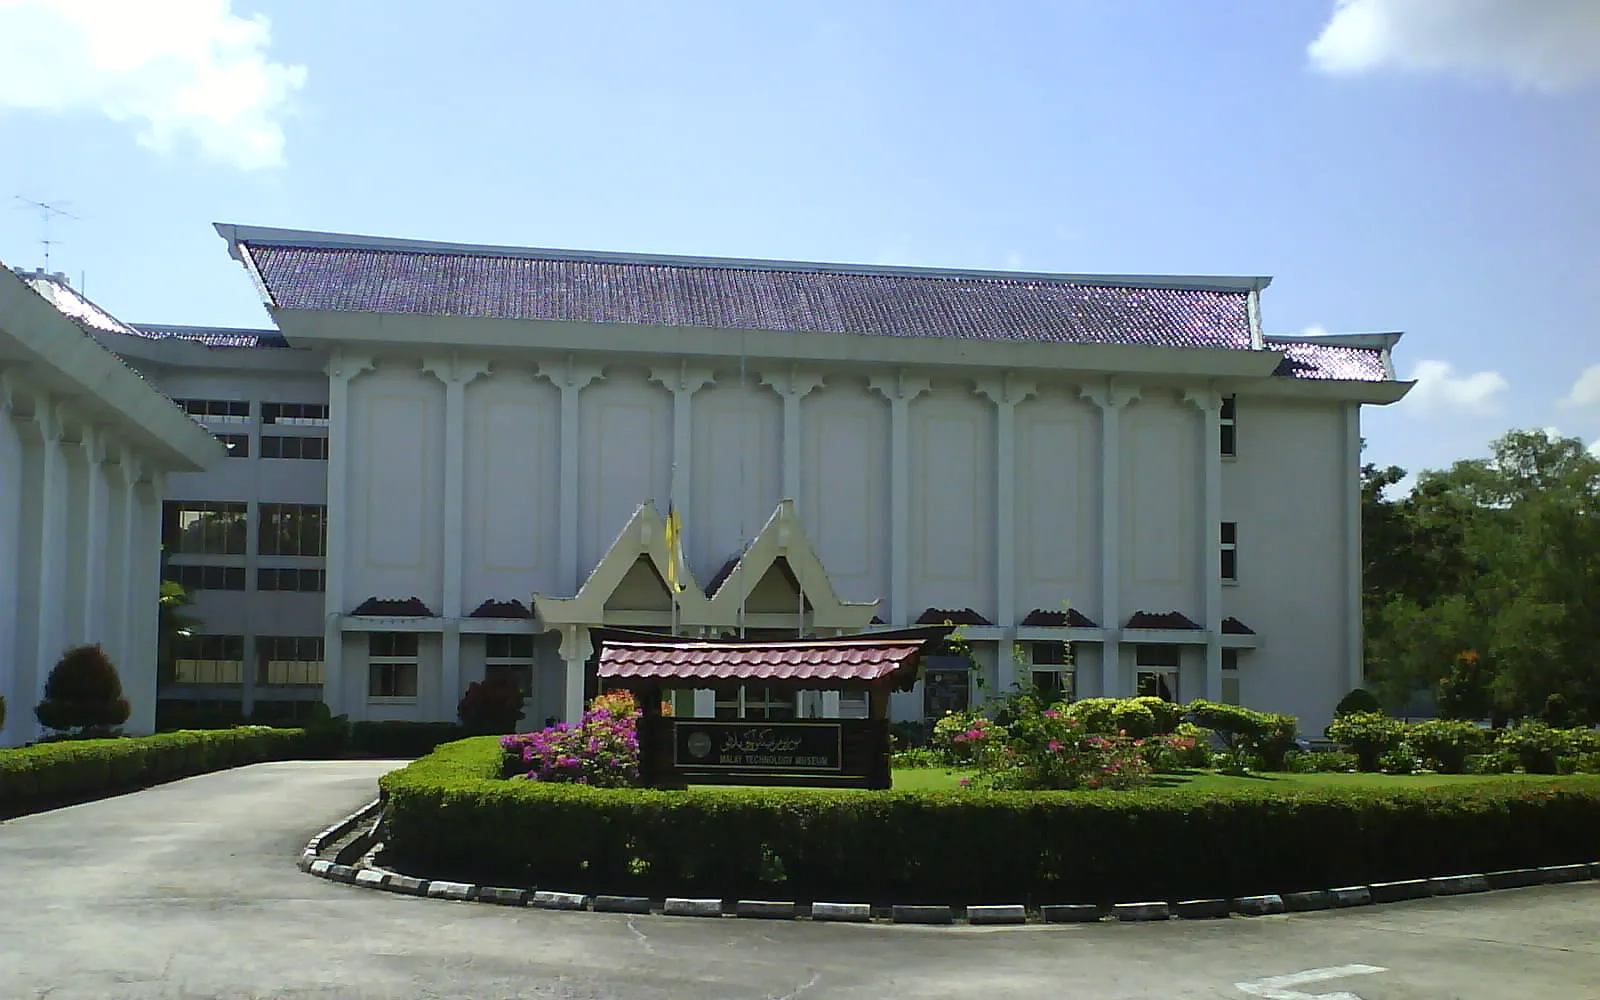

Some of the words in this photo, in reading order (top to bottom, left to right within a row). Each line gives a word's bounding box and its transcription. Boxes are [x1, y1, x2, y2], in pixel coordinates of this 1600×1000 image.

[719, 754, 743, 764] MALAY
[745, 755, 793, 765] TECHNOLOGY
[795, 755, 829, 766] MUSEUM
